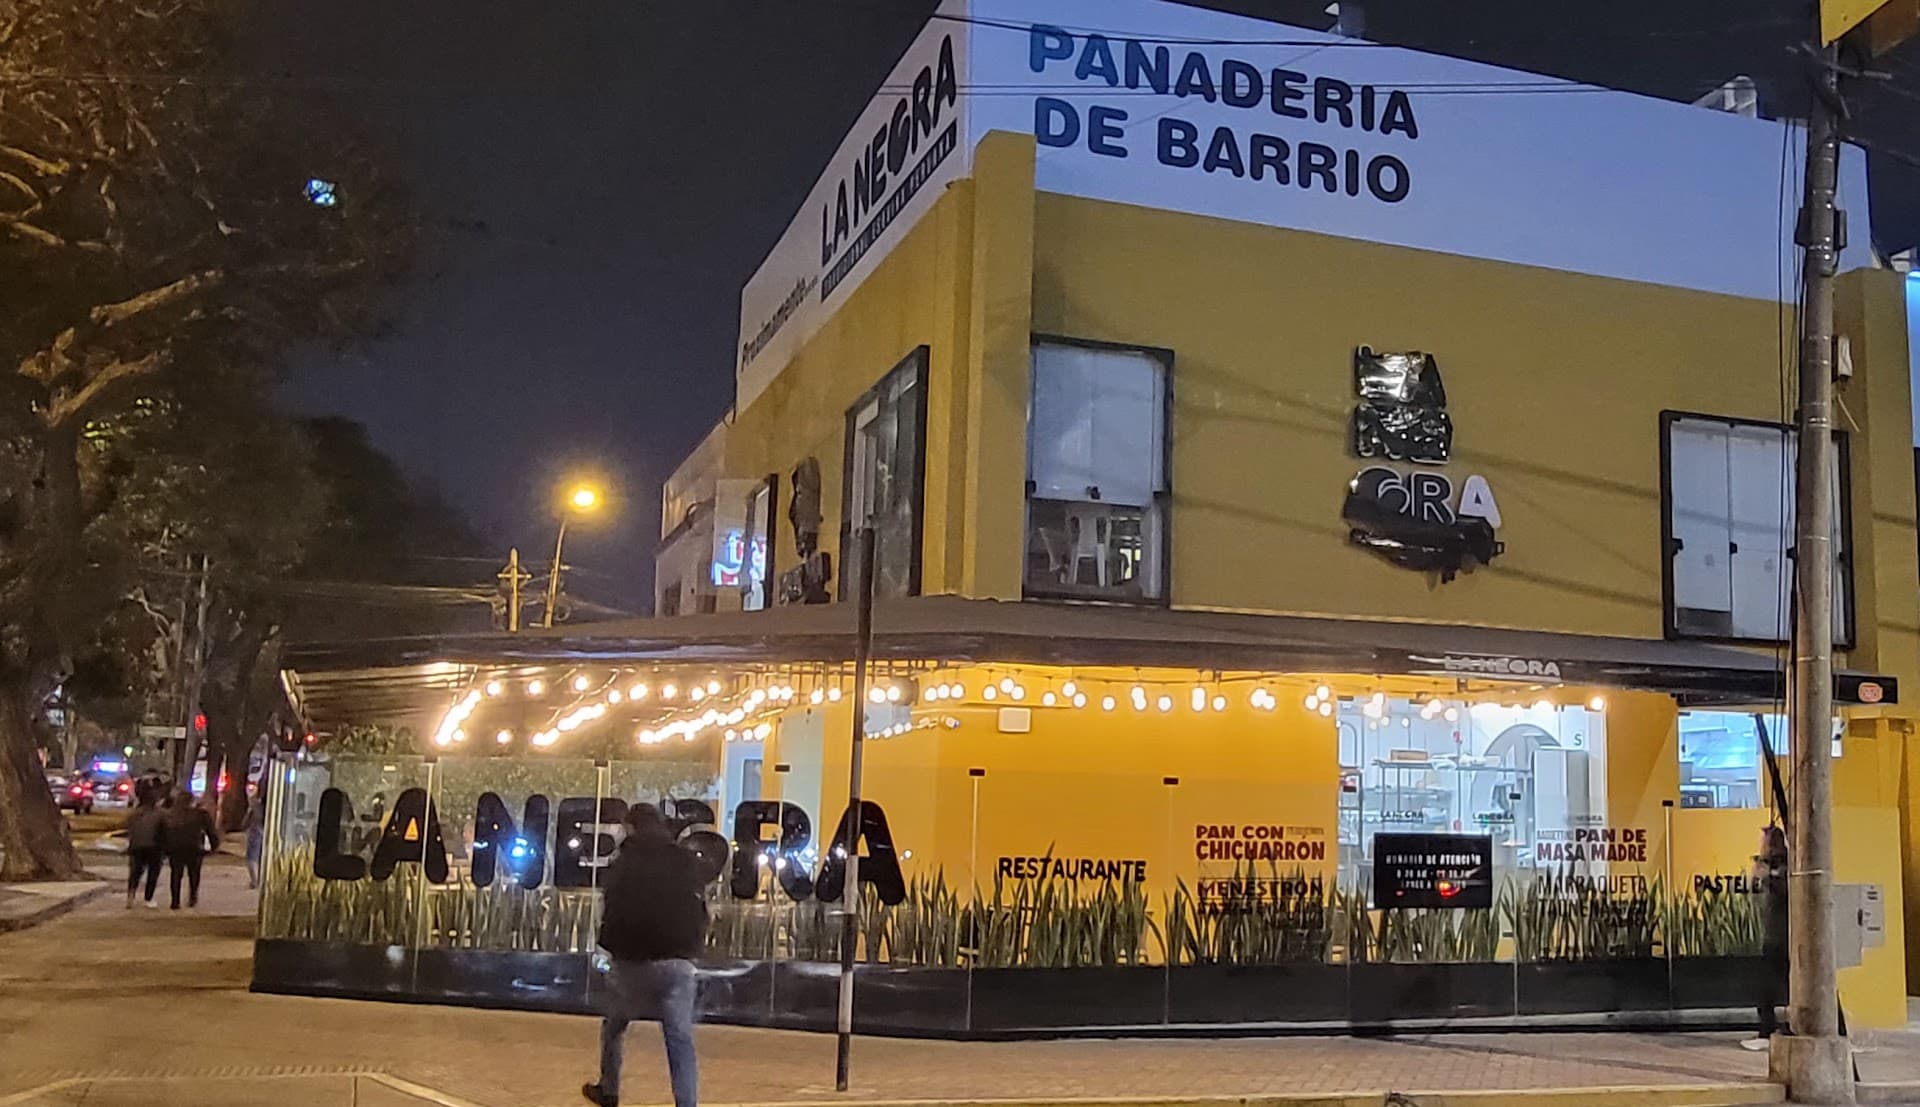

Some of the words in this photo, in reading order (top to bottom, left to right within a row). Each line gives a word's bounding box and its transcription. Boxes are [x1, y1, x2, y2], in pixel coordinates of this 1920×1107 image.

[1029, 24, 1419, 139] PANADERIA
[1034, 97, 1129, 158] DE
[1157, 117, 1411, 203] BARRIO
[314, 787, 449, 884] LA
[1196, 825, 1236, 839] PAN
[1242, 826, 1285, 840] CON
[1575, 828, 1617, 842] PAN
[1622, 829, 1647, 843] DE
[1537, 843, 1586, 861] MASA
[1591, 844, 1647, 862] MADRE
[999, 857, 1147, 882] RESTAURANTE
